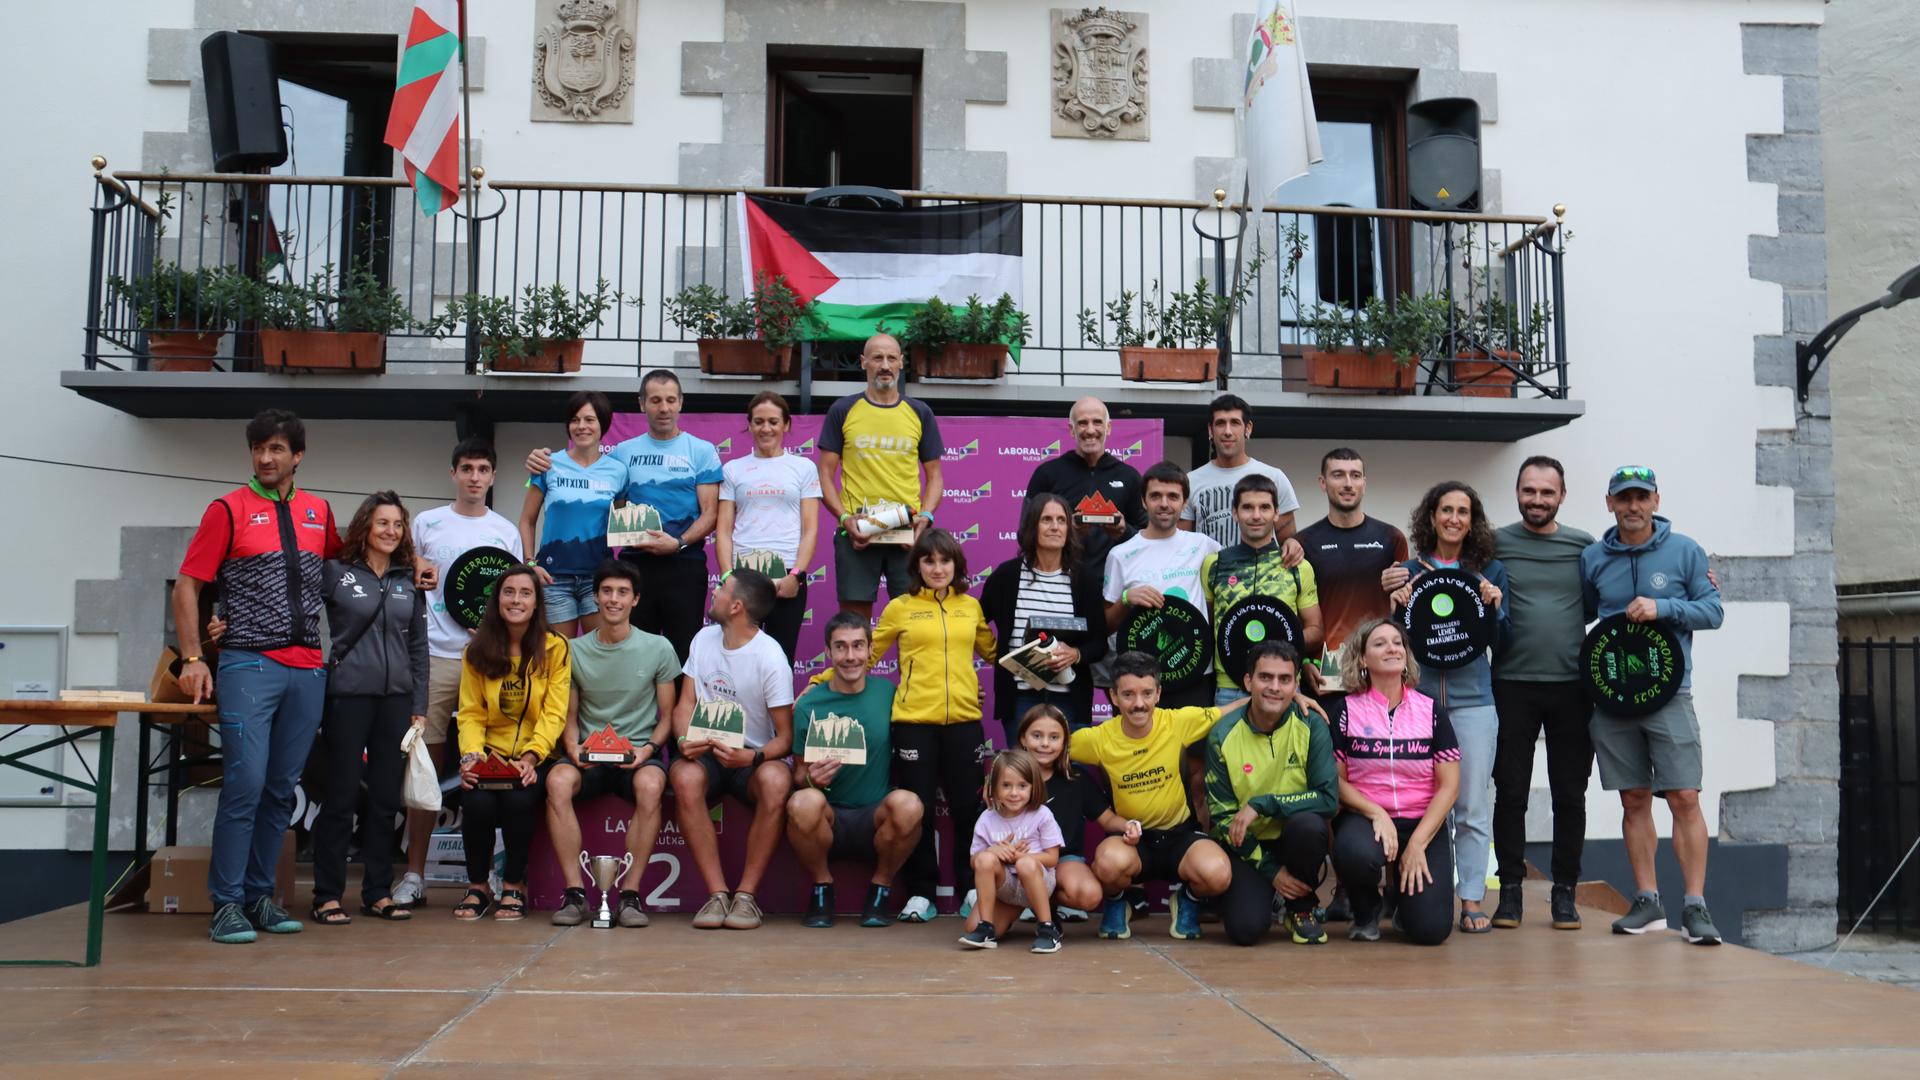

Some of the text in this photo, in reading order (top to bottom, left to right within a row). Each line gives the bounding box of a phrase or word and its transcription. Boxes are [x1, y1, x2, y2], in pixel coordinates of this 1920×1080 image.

[998, 447, 1041, 456] LABORAL
[629, 454, 664, 468] INTXIXU
[556, 476, 590, 490] INTXIXU
[1446, 577, 1466, 588] trail
[1165, 606, 1193, 623] 2025
[1257, 604, 1276, 614] trail
[1438, 627, 1456, 636] LEHEN
[1122, 766, 1166, 782] GAIKAR
[656, 835, 685, 845] utxa
[645, 853, 680, 906] 2
